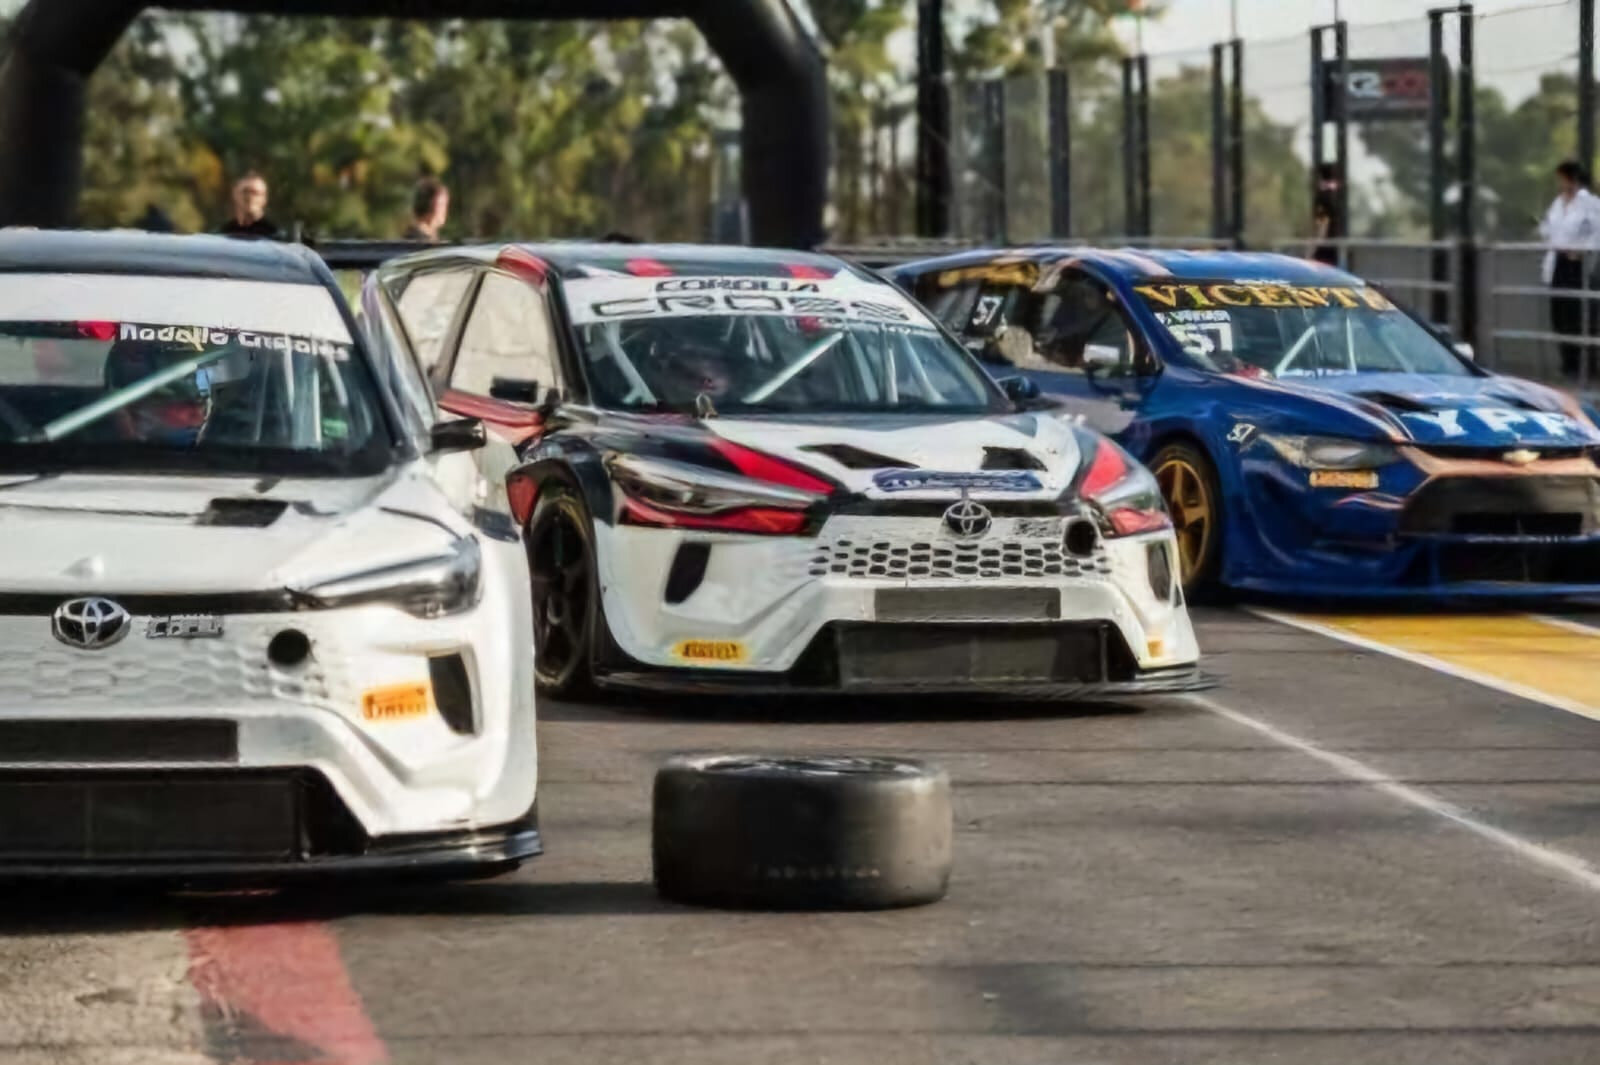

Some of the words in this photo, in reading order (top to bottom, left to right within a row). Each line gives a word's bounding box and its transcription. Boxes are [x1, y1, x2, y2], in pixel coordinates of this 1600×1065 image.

[591, 294, 910, 322] CROSS
[972, 295, 1004, 325] 57
[1399, 407, 1582, 441] YPF
